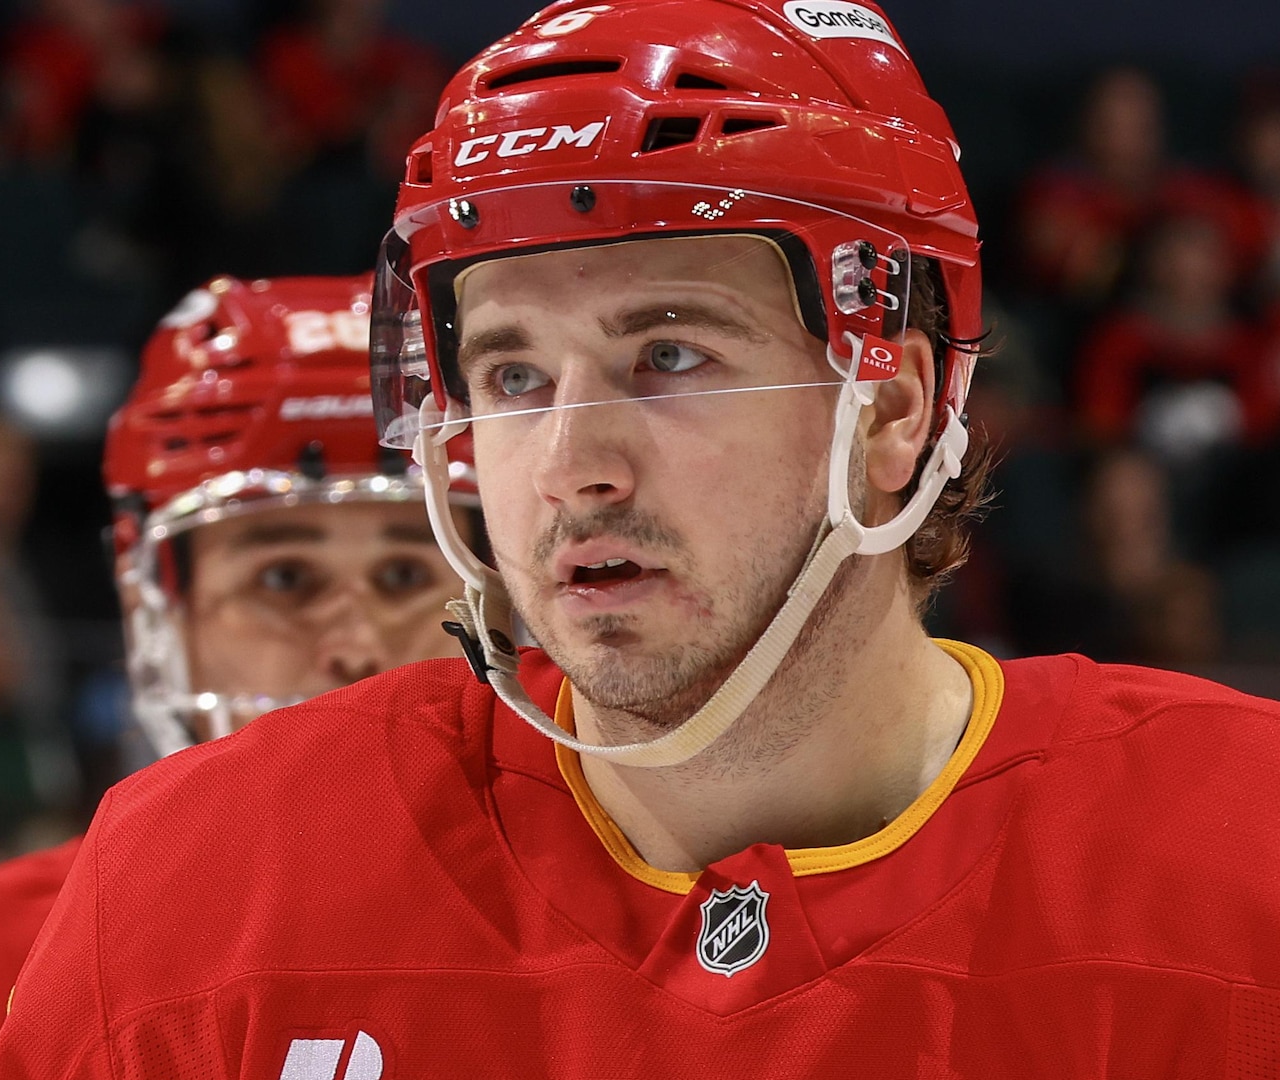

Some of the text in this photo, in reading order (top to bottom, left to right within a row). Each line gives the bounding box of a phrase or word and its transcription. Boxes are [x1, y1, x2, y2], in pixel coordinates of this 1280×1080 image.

[538, 4, 614, 38] 6
[795, 8, 892, 38] GameSe
[454, 122, 605, 167] CCM
[863, 357, 897, 373] OAKLEY
[712, 906, 753, 959] NHL
